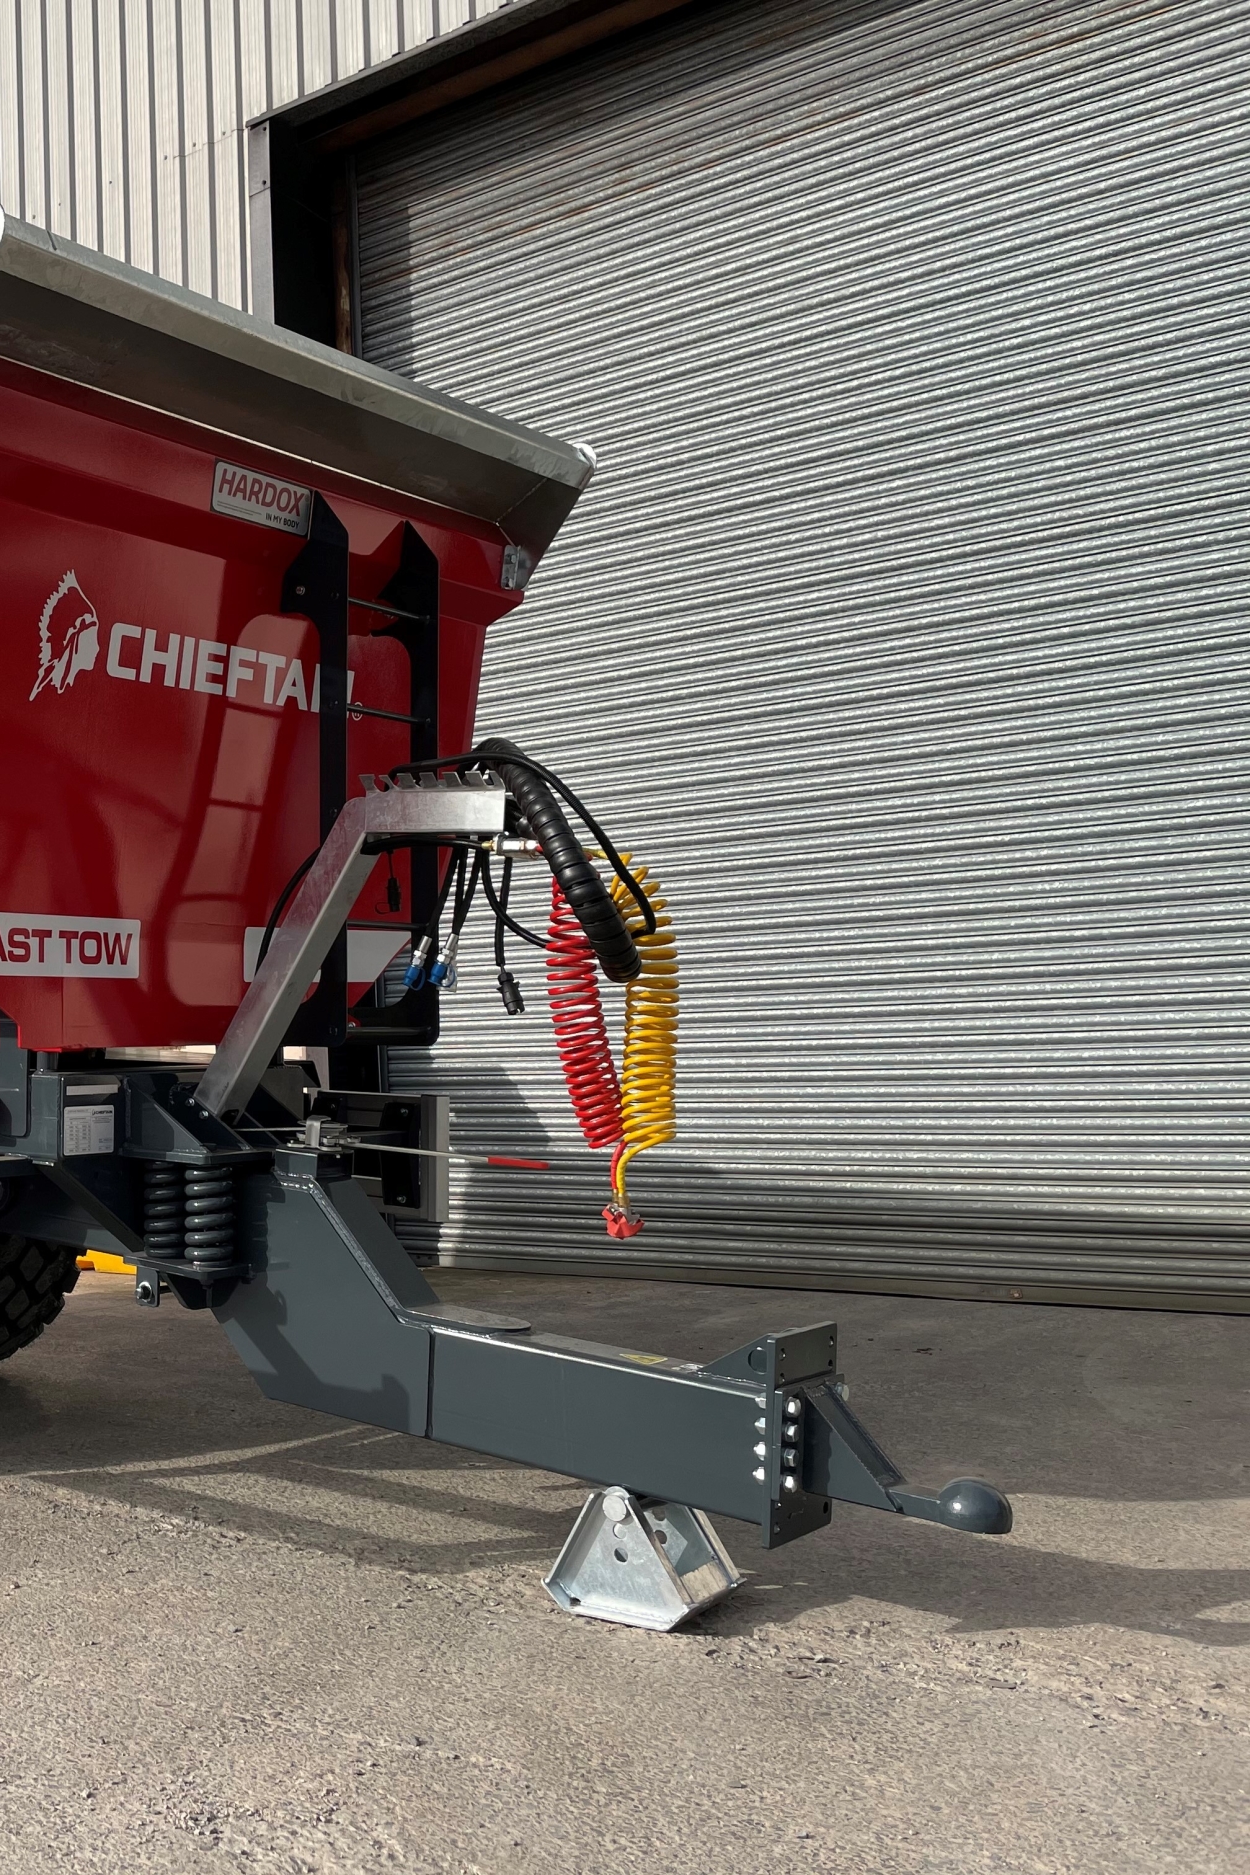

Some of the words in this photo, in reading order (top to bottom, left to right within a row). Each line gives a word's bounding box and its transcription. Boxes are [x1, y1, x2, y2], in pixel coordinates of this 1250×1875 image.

[219, 468, 305, 517] HARDOX
[266, 513, 272, 521] IN
[273, 514, 282, 524] MY
[283, 517, 300, 529] BODY
[59, 930, 133, 966] TOW
